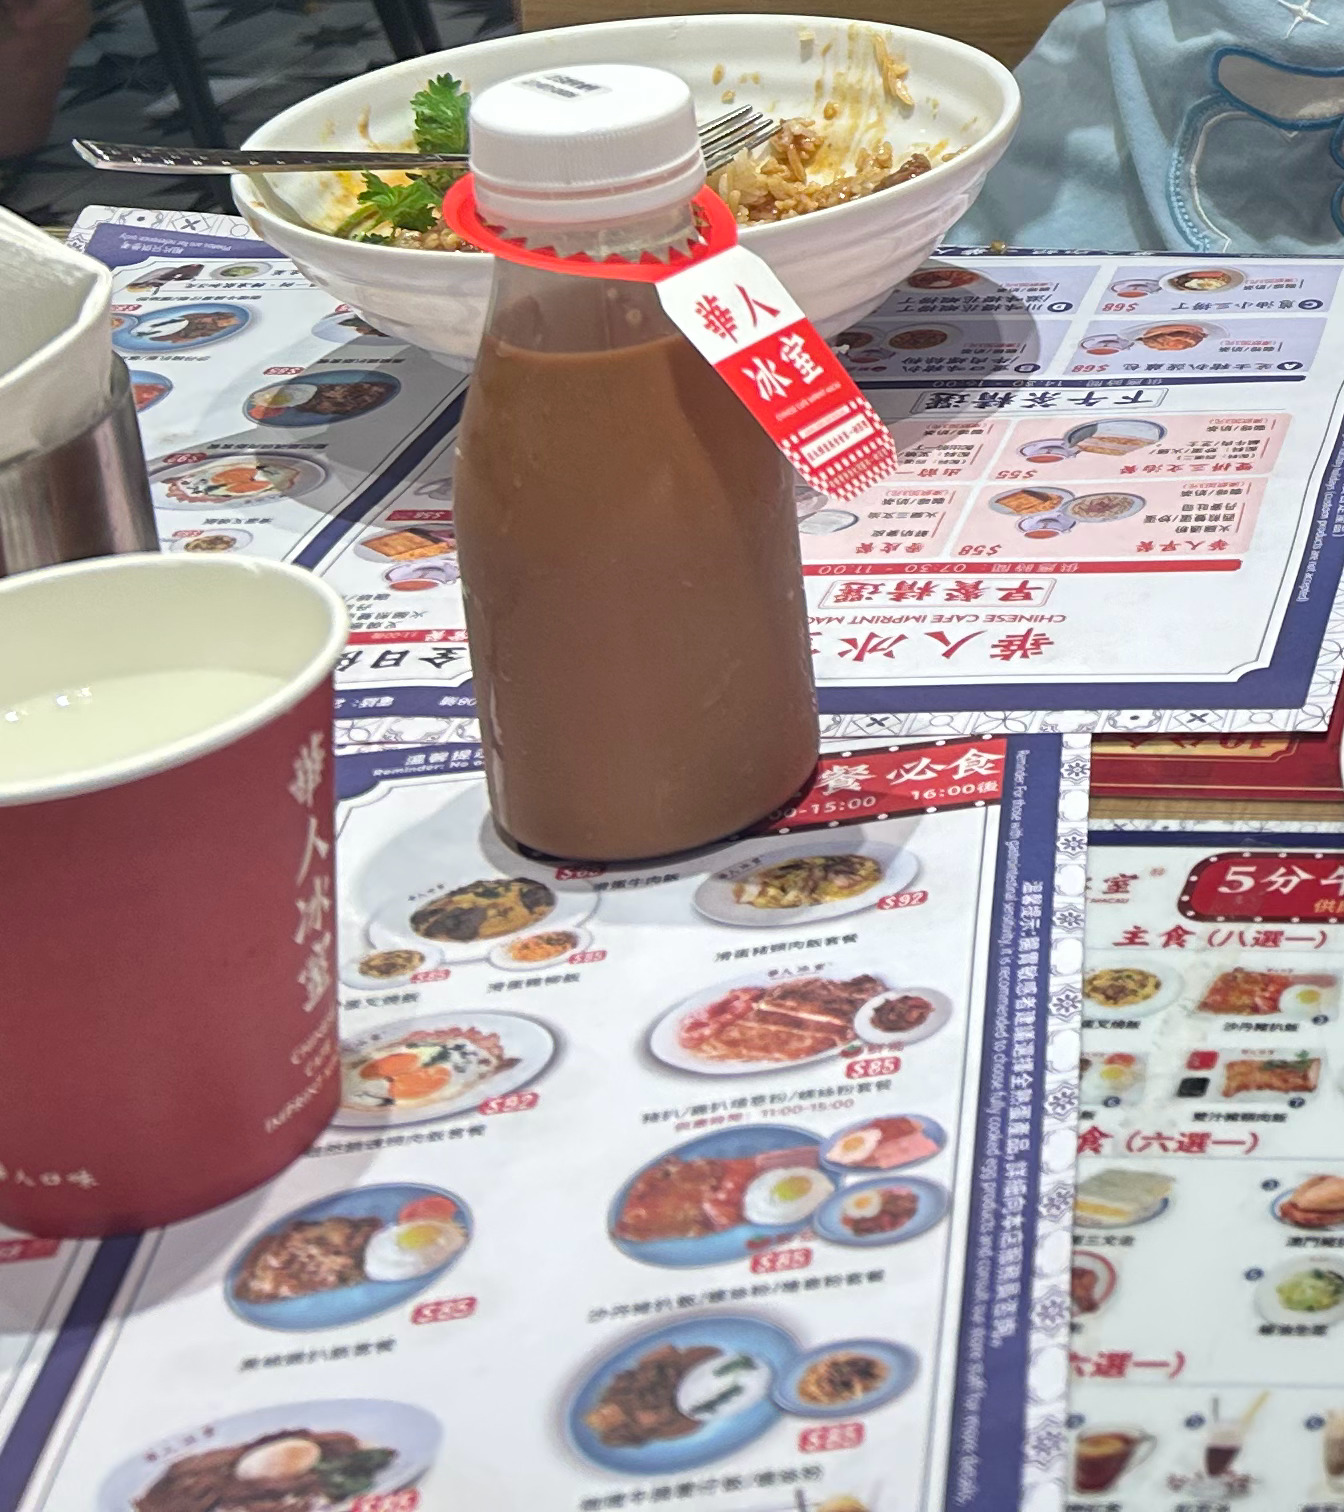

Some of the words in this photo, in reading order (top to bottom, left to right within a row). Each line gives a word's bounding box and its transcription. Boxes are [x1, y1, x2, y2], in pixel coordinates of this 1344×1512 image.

[693, 283, 782, 344] 華人
[1100, 302, 1138, 313] $68
[740, 331, 825, 403] 冰室
[1070, 362, 1109, 373] $68
[922, 390, 1154, 409] 下午茶精選
[993, 468, 1036, 480] $55
[957, 544, 1002, 557] $58
[1134, 539, 1229, 553] 華人早餐
[832, 579, 1043, 603] 早餐精選
[846, 614, 928, 625] IMPRINT
[929, 613, 980, 624] CAFE
[984, 612, 1067, 625] CHINESE
[812, 627, 1053, 663] 華人冰
[373, 761, 444, 777] Reminder:
[817, 747, 1004, 796] 餐必食
[908, 780, 999, 802] 16:00後
[1086, 872, 1141, 896] 室
[880, 890, 924, 909] $92
[1112, 924, 1198, 949] 主食
[1207, 927, 1329, 950] (八選一)
[848, 1056, 897, 1078] $85
[484, 1092, 537, 1114] $92
[1125, 1129, 1260, 1156] (六選一)
[753, 1249, 809, 1274] $85
[802, 1426, 863, 1452] $85
